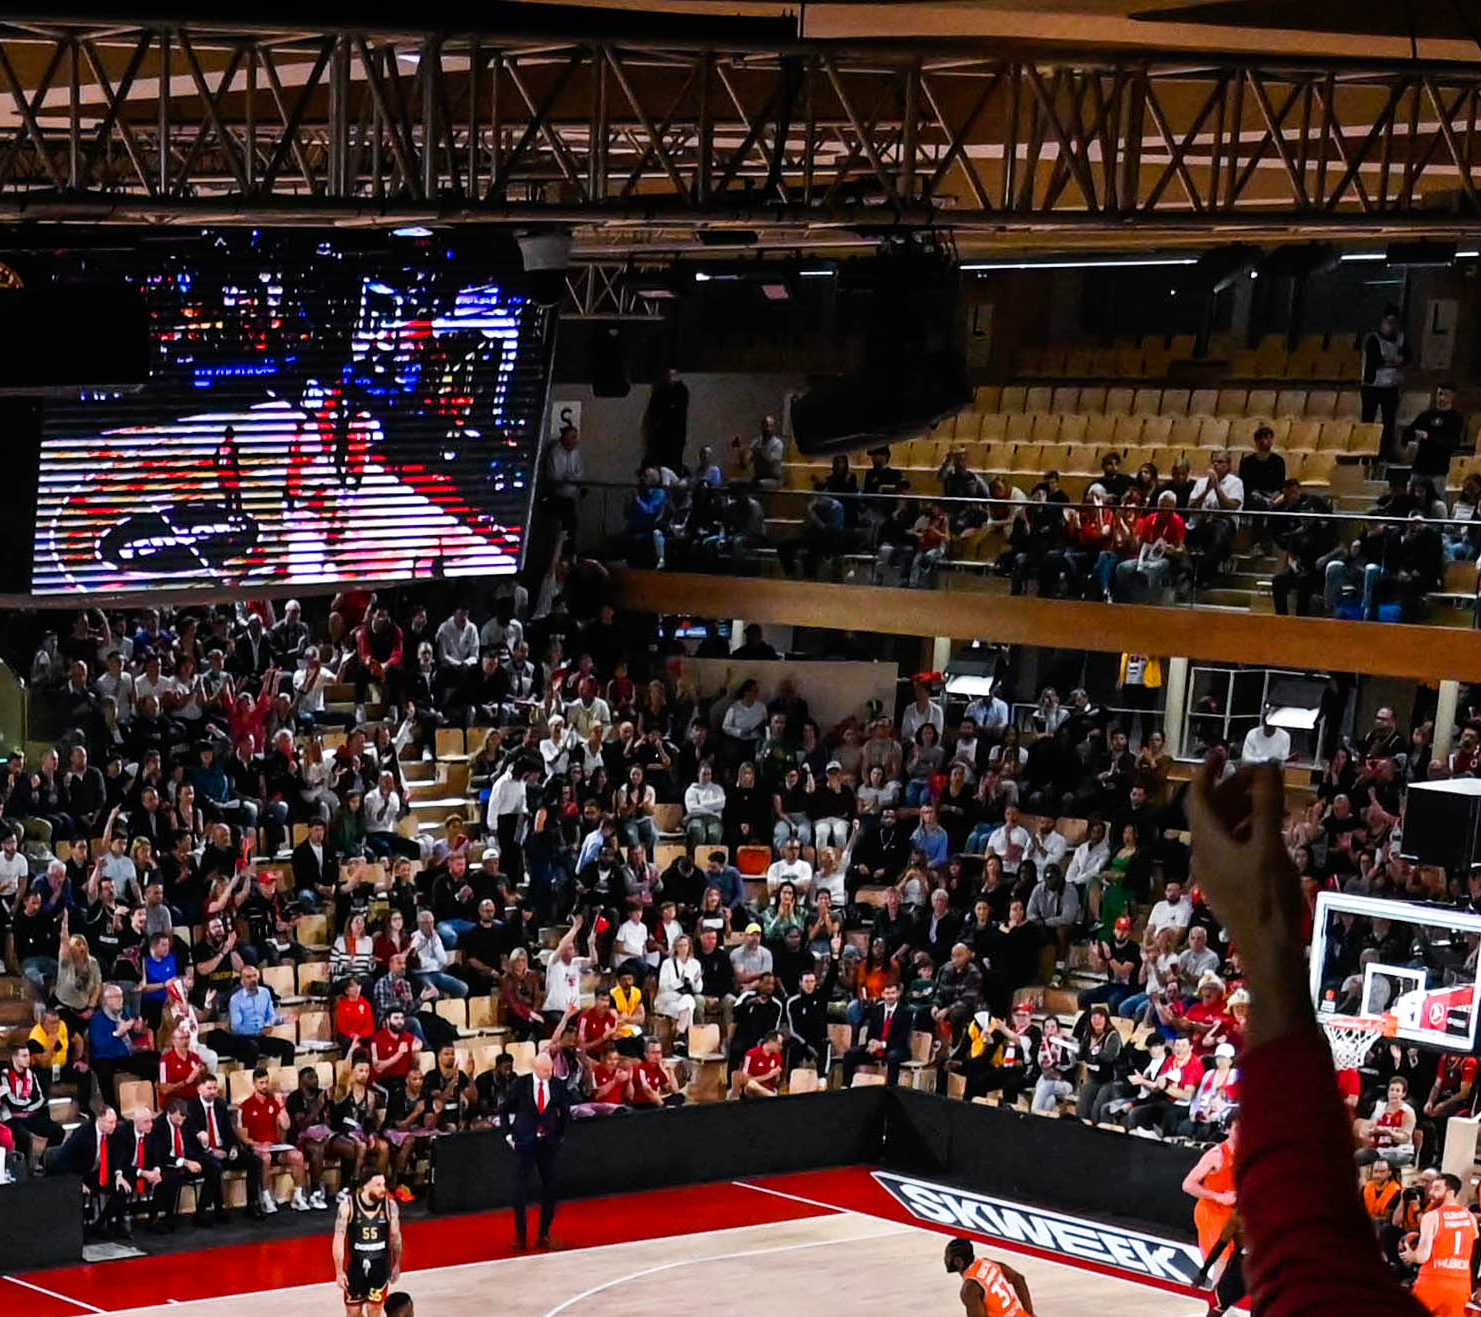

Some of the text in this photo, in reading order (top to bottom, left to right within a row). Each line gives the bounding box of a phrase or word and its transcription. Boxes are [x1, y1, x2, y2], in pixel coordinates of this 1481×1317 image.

[1432, 303, 1448, 335] L
[362, 1227, 378, 1240] 55
[899, 1183, 1200, 1285] SKWEEK
[1454, 1231, 1461, 1255] 1
